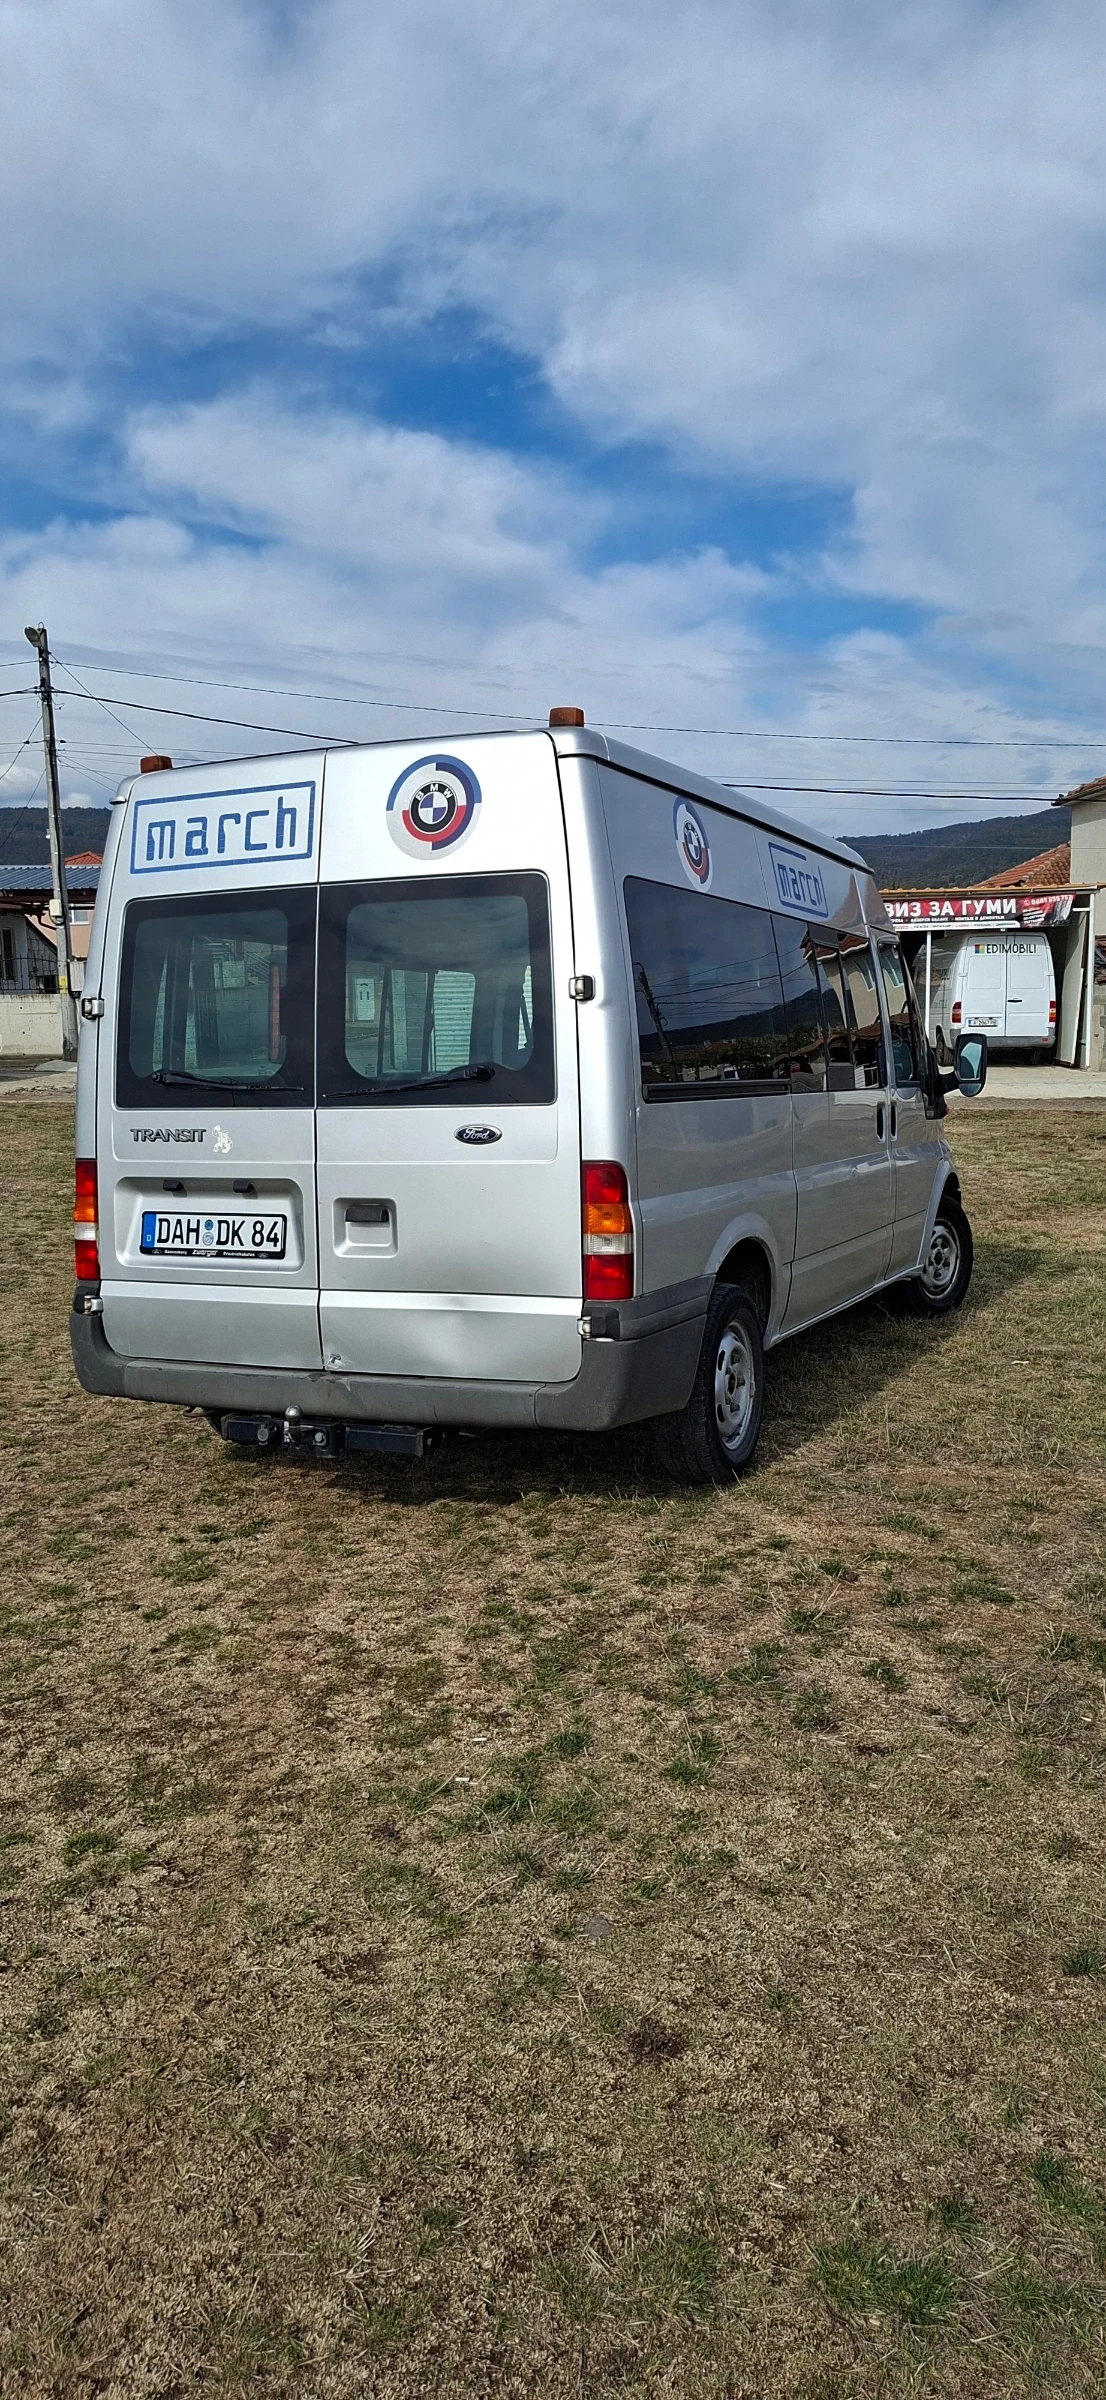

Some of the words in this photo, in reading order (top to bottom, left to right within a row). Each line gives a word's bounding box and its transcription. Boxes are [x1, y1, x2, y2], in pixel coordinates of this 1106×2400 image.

[416, 783, 453, 801] BMW
[146, 796, 297, 861] march
[928, 900, 955, 917] ЗА
[962, 898, 1017, 916] ГУМИ
[986, 943, 1037, 954] EDIMOBILI
[130, 1128, 207, 1143] TRANSIT
[463, 1127, 490, 1140] Ford
[146, 1234, 152, 1242] D
[157, 1218, 200, 1245] DAH
[216, 1219, 246, 1247] DK
[251, 1220, 280, 1248] 84
